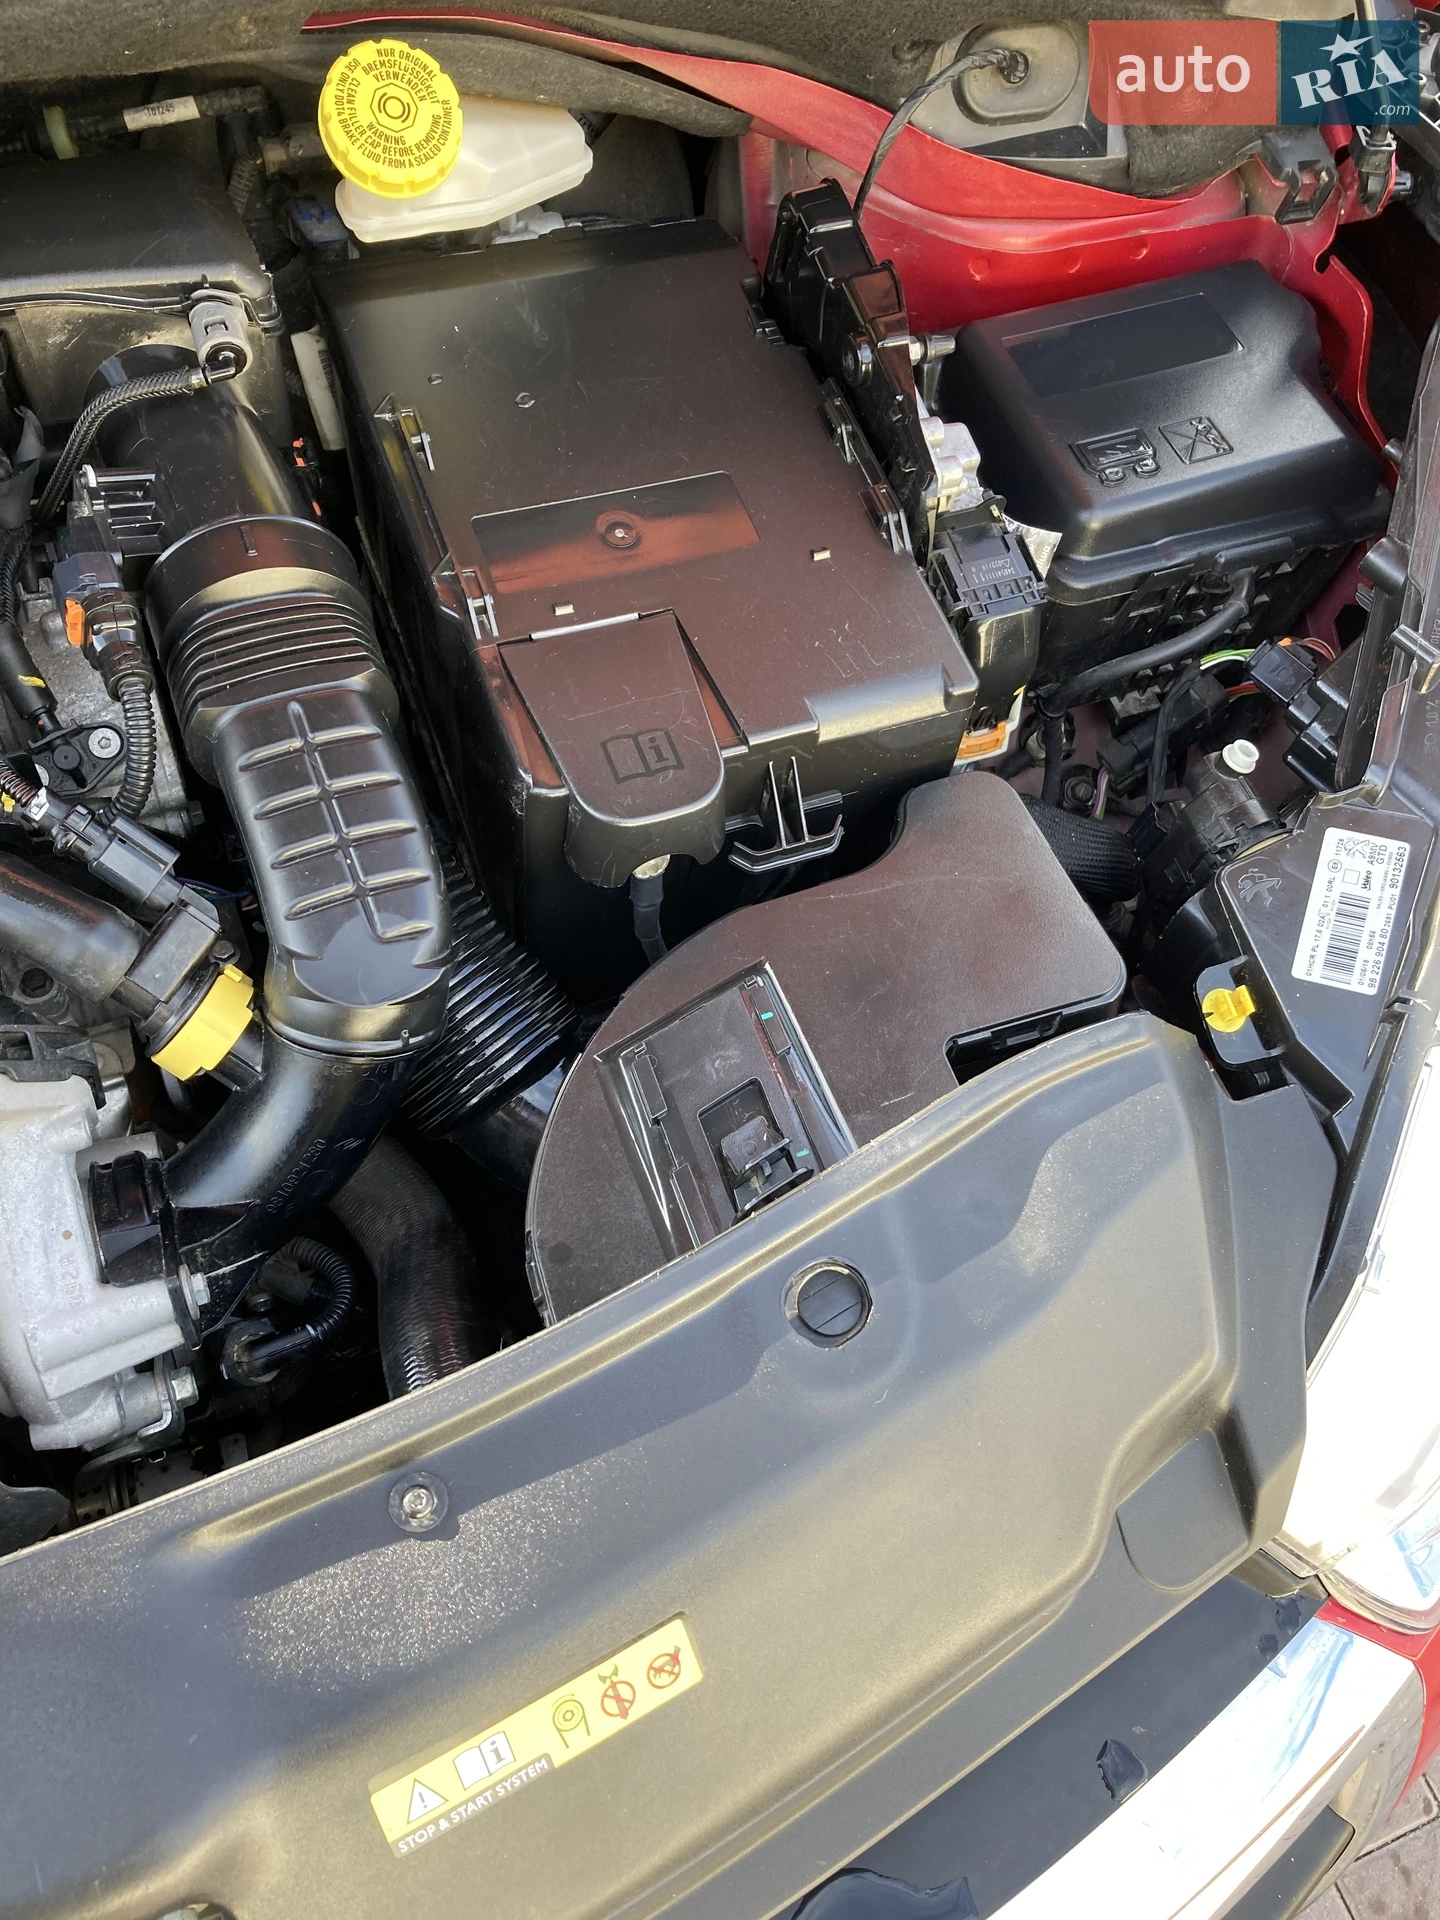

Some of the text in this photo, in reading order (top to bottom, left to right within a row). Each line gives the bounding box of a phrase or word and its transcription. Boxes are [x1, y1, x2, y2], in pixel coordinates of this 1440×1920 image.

[377, 48, 437, 82] NUR ORIGINAL
[372, 71, 428, 102] VERWENDEN
[334, 58, 452, 168] USE ONLY DOT4 BRAKE FLUID FROM A SEALED CONTAINER
[346, 78, 442, 157] CLEAN FILLER CAP BEFORE REMOVING
[366, 122, 406, 146] WARNING
[1376, 844, 1388, 864] GTD
[1389, 846, 1406, 888] 90132563
[1380, 928, 1388, 940] 80
[1375, 941, 1386, 958] 904
[1371, 960, 1382, 976] 226
[1368, 978, 1376, 988] 98
[398, 1757, 548, 1853] STOP & START SYSTEM
